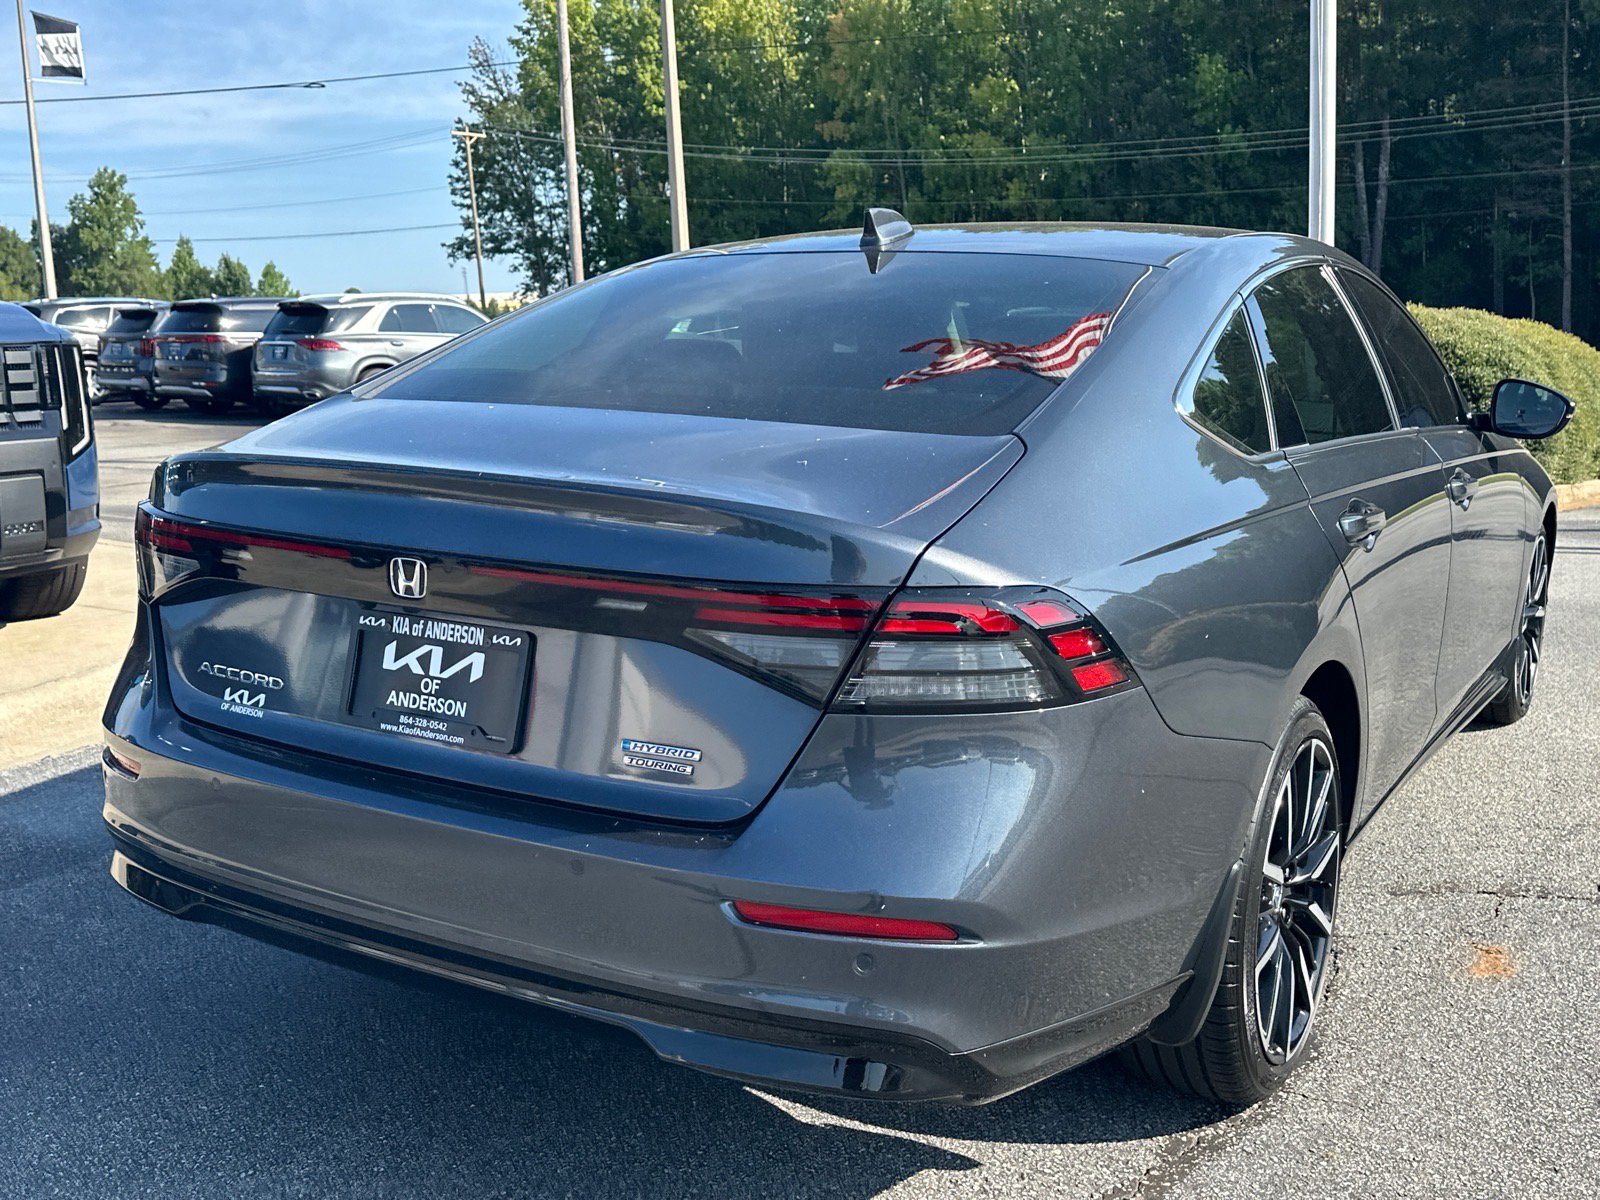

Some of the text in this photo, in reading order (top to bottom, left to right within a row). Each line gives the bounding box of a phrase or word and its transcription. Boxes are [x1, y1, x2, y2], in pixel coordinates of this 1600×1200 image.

[392, 615, 485, 646] KIA of ANDERSON
[382, 640, 486, 684] KIA
[197, 661, 284, 690] ACCORD
[420, 678, 441, 695] OF
[220, 702, 264, 718] OF ANDERSON
[386, 690, 467, 718] ANDERSON
[399, 714, 448, 731] 864-328-0542
[380, 722, 465, 744] www.KiaofAnderson.com
[632, 743, 696, 759] HYBRID
[627, 756, 687, 773] TOURING
